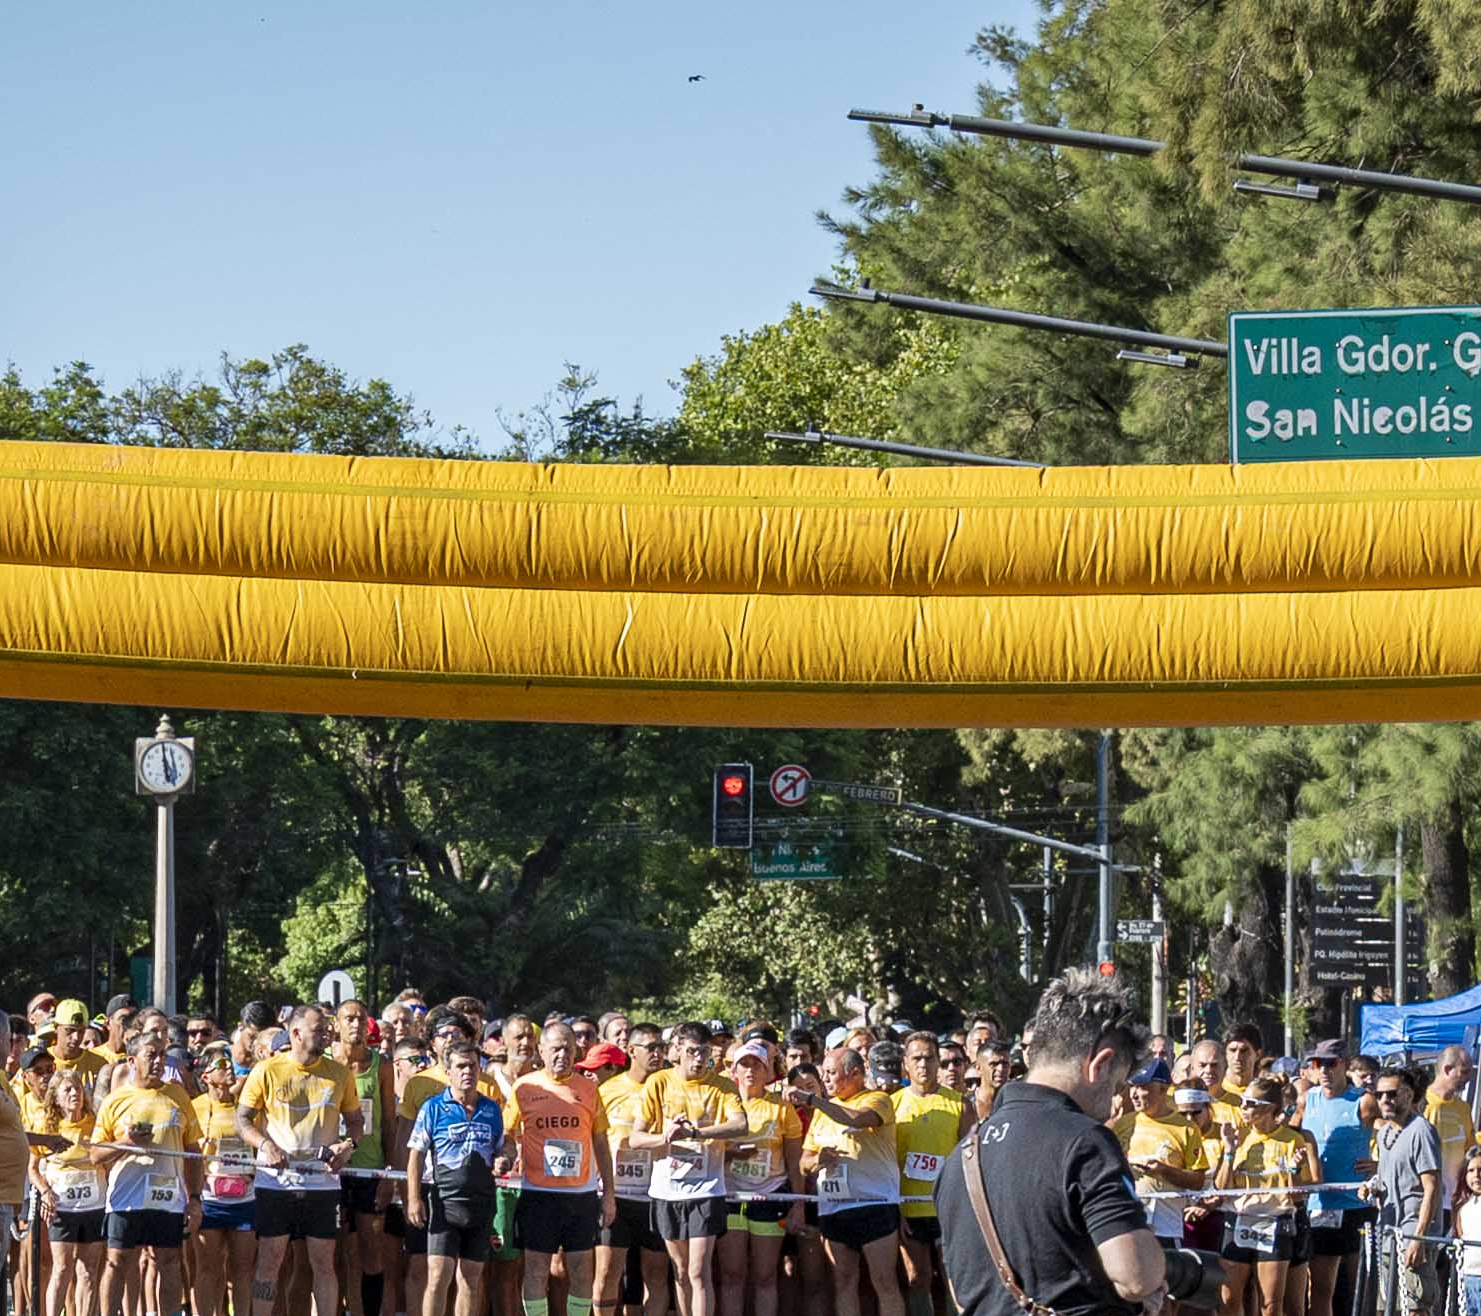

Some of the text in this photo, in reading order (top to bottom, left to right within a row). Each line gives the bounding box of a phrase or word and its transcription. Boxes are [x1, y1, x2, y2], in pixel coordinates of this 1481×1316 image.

[1244, 338, 1322, 375] Villa
[1338, 335, 1437, 375] Gdor.
[1246, 396, 1474, 437] San Nicolás
[536, 1116, 580, 1129] CIEGO
[550, 1156, 575, 1169] 245
[912, 1153, 937, 1171] 759
[617, 1164, 643, 1177] 345
[67, 1186, 91, 1200] 373
[151, 1189, 173, 1201] 153
